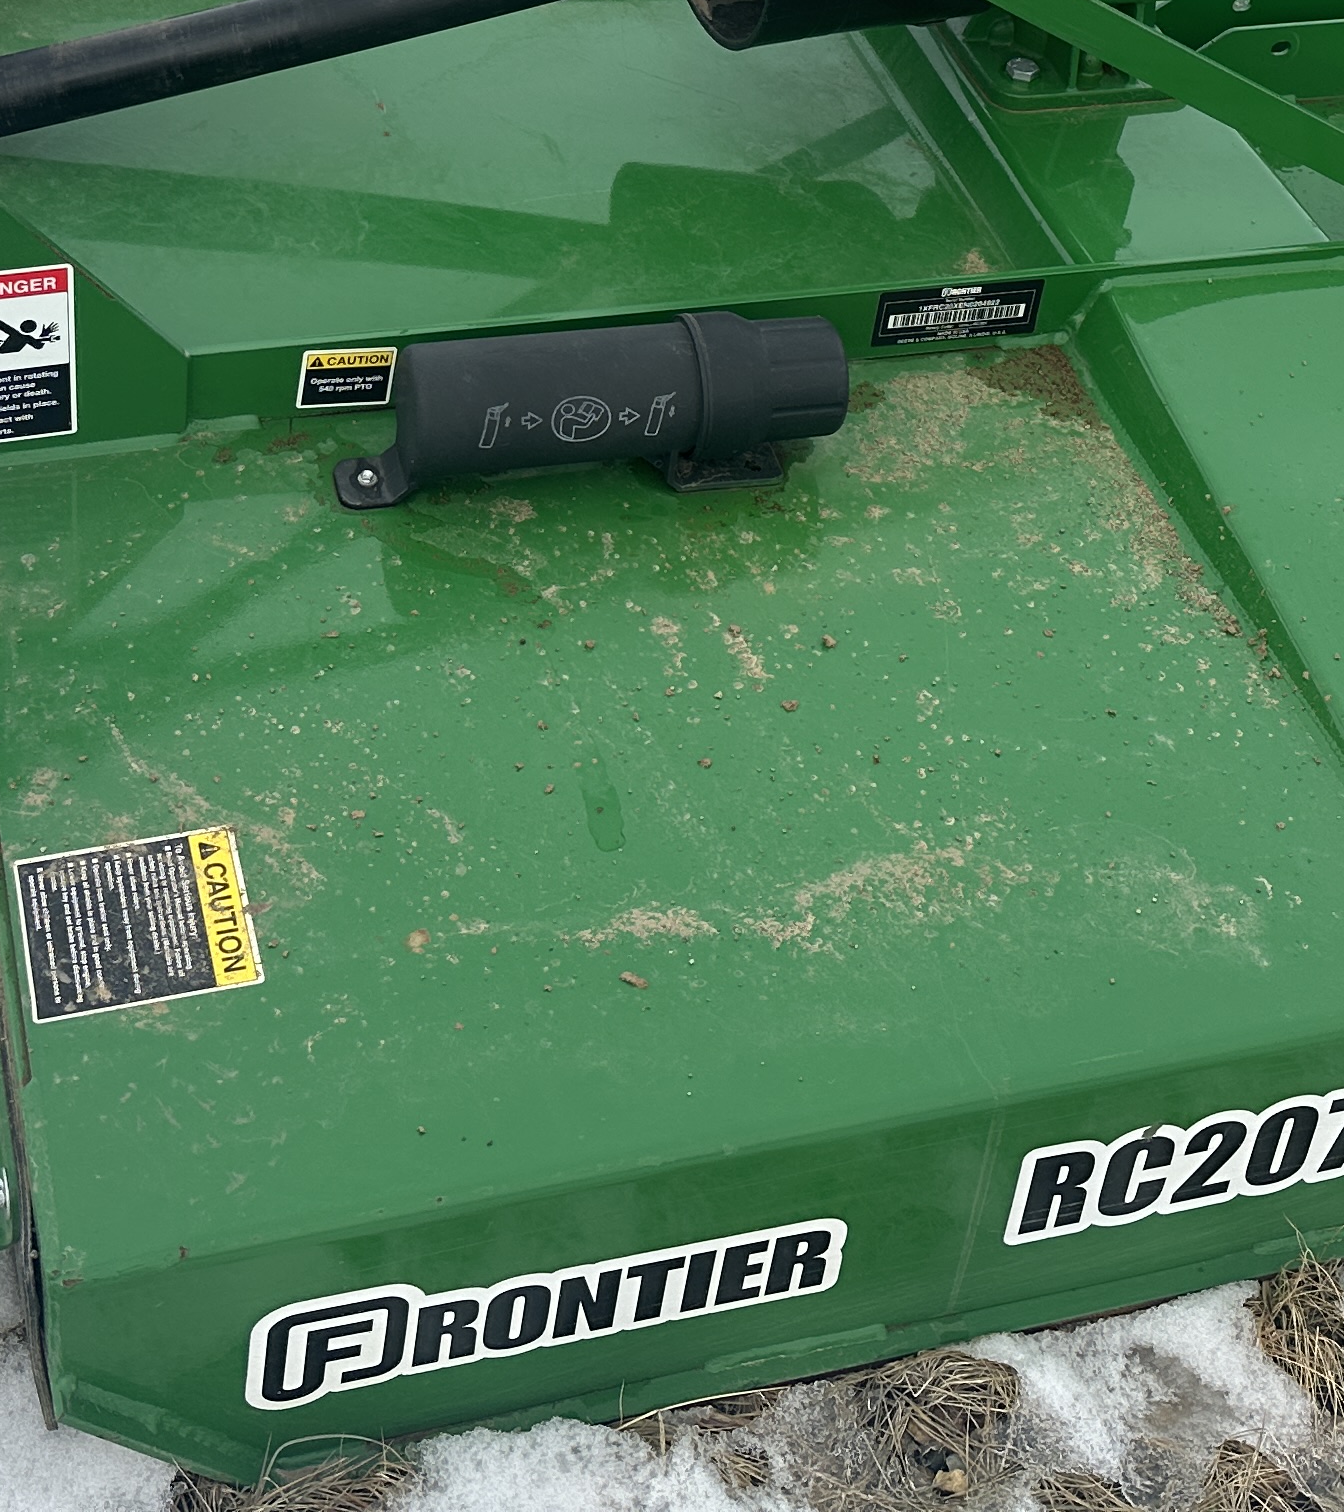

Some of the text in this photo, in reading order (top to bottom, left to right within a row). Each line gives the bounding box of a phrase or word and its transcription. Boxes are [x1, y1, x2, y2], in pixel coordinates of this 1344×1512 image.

[327, 354, 390, 366] CAUTION
[24, 370, 58, 381] rotating
[310, 377, 344, 385] Operate
[346, 376, 364, 384] only
[9, 382, 36, 390] cause
[23, 388, 52, 398] death.
[33, 399, 60, 410] place.
[14, 413, 34, 422] with
[203, 862, 246, 973] CAUTION
[262, 1229, 834, 1403] FRONTIER
